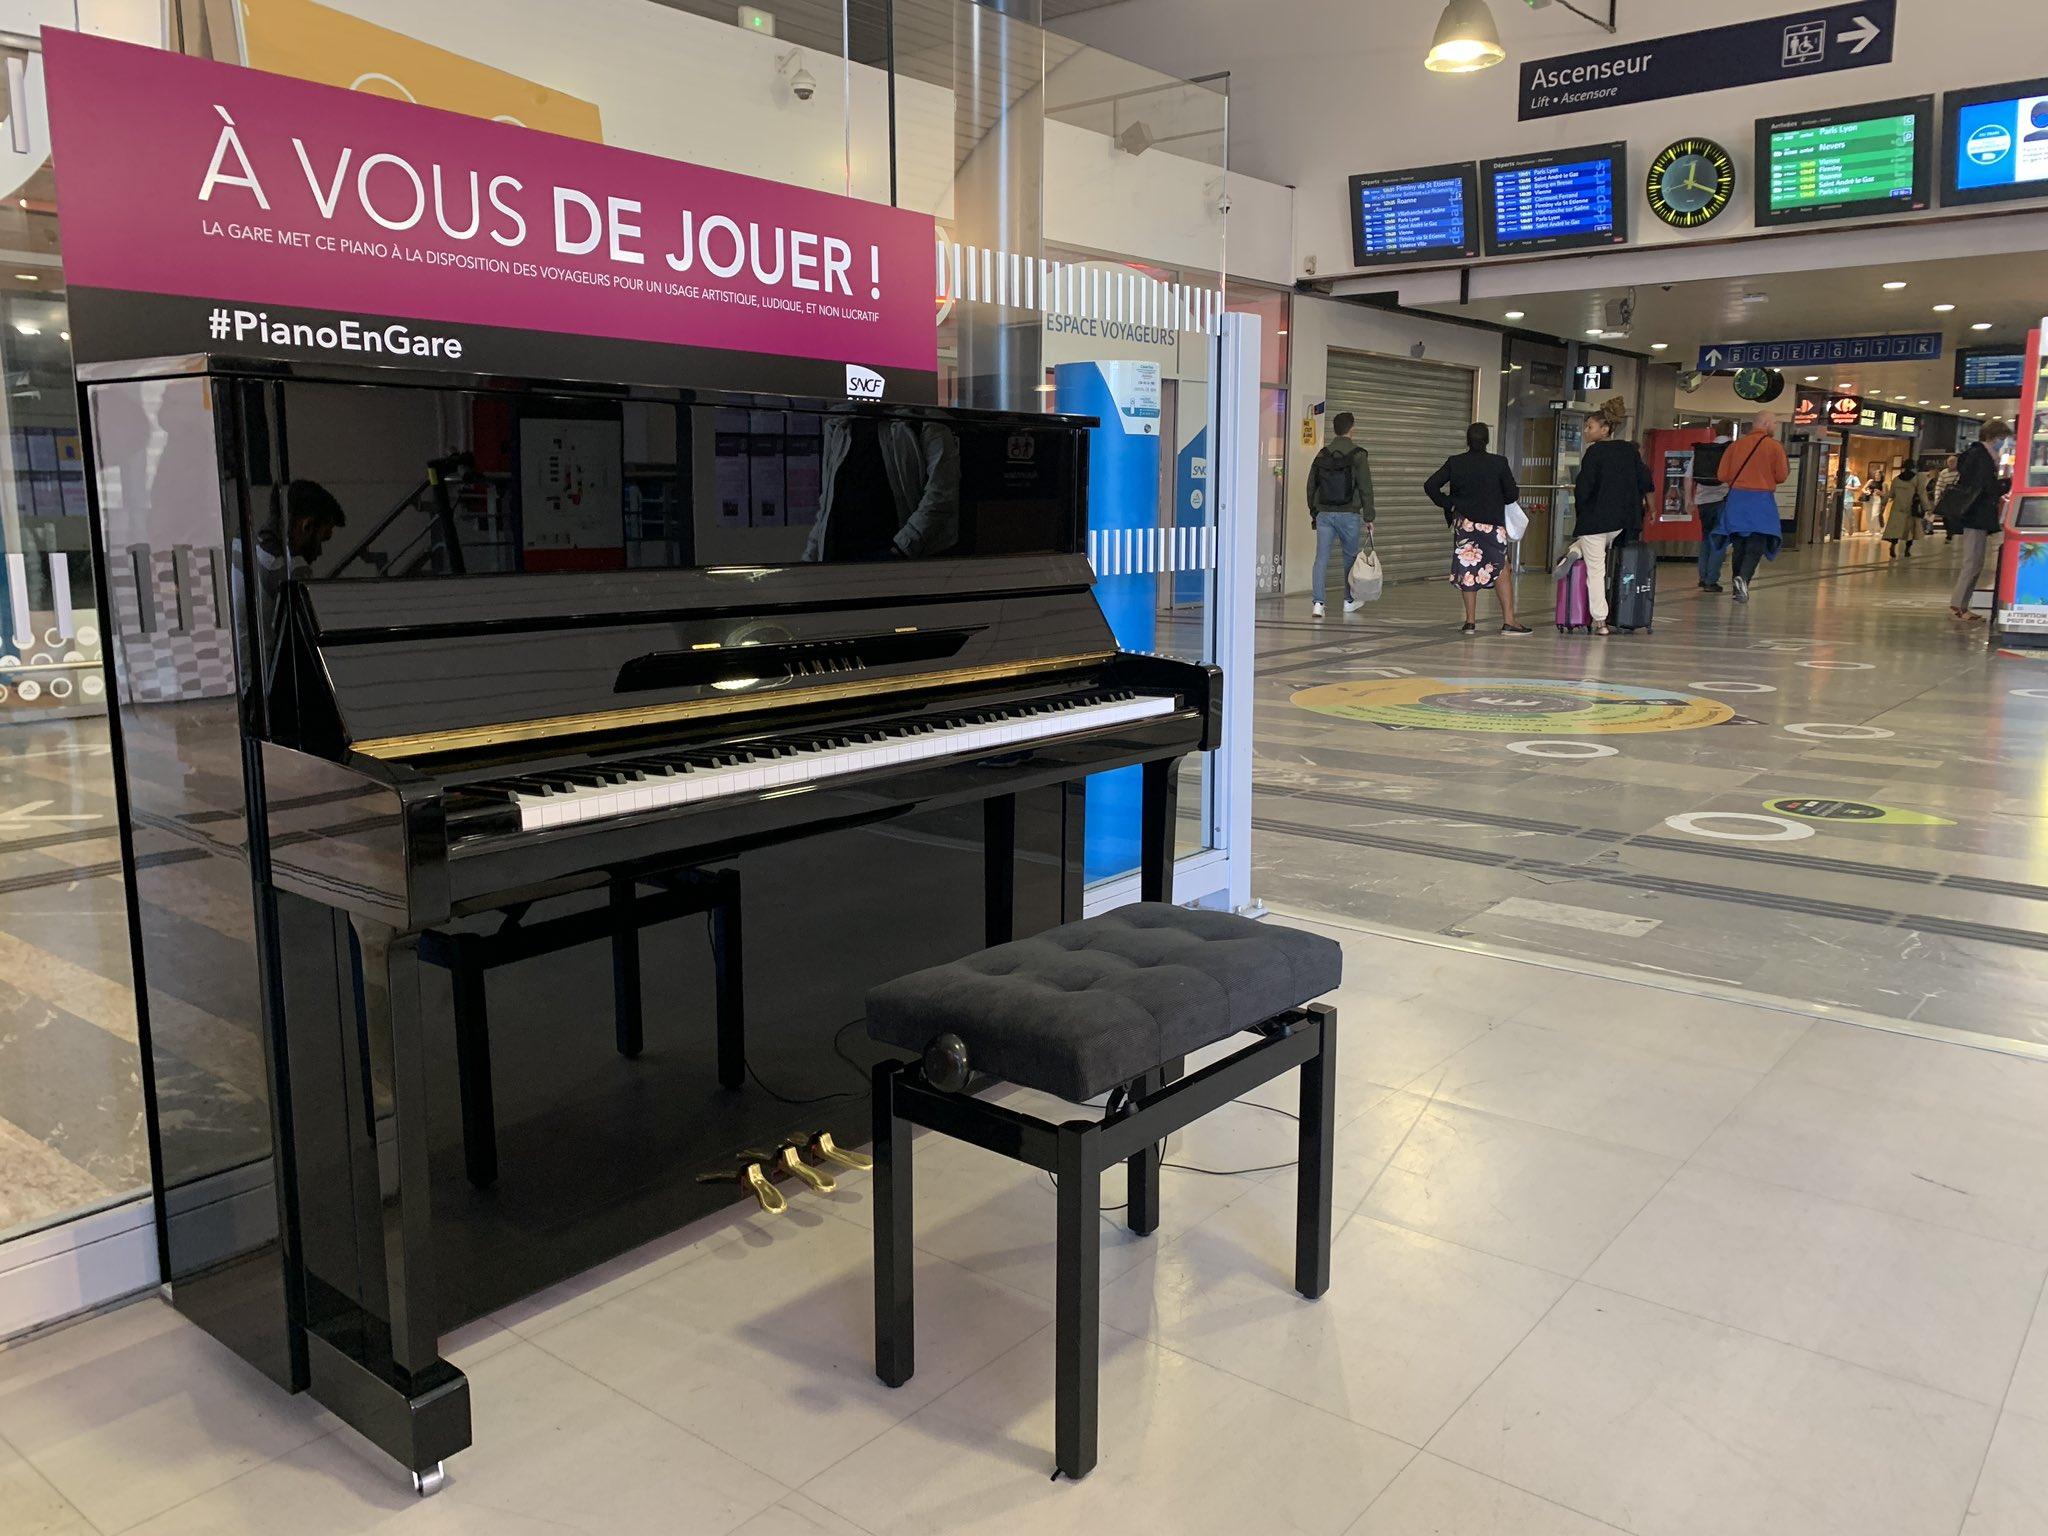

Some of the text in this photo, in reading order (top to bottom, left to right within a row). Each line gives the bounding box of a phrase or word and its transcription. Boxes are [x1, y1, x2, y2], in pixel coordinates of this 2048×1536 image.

[1531, 52, 1653, 91] Ascenseur
[1530, 85, 1618, 110] Lift Ascensore
[1819, 127, 1838, 136] Paris
[1839, 125, 1858, 135] Lyon
[1819, 141, 1846, 151] Nevers
[198, 105, 880, 300] À VOUS DE JOUER !
[1535, 202, 1554, 210] Firminy
[203, 220, 880, 323] LA GARE MET CE PIANO À LA DISPOSITION DES VOYAGEURS POUR UN USAGE ARTISTIQUE, LUDIQUE, ET NON LUCRATIF
[208, 308, 463, 359] #PianoEnGare
[1046, 312, 1175, 346] ESPACE VOYAGEURS
[848, 377, 882, 393] SNCF
[784, 655, 867, 678] YAMAHA
